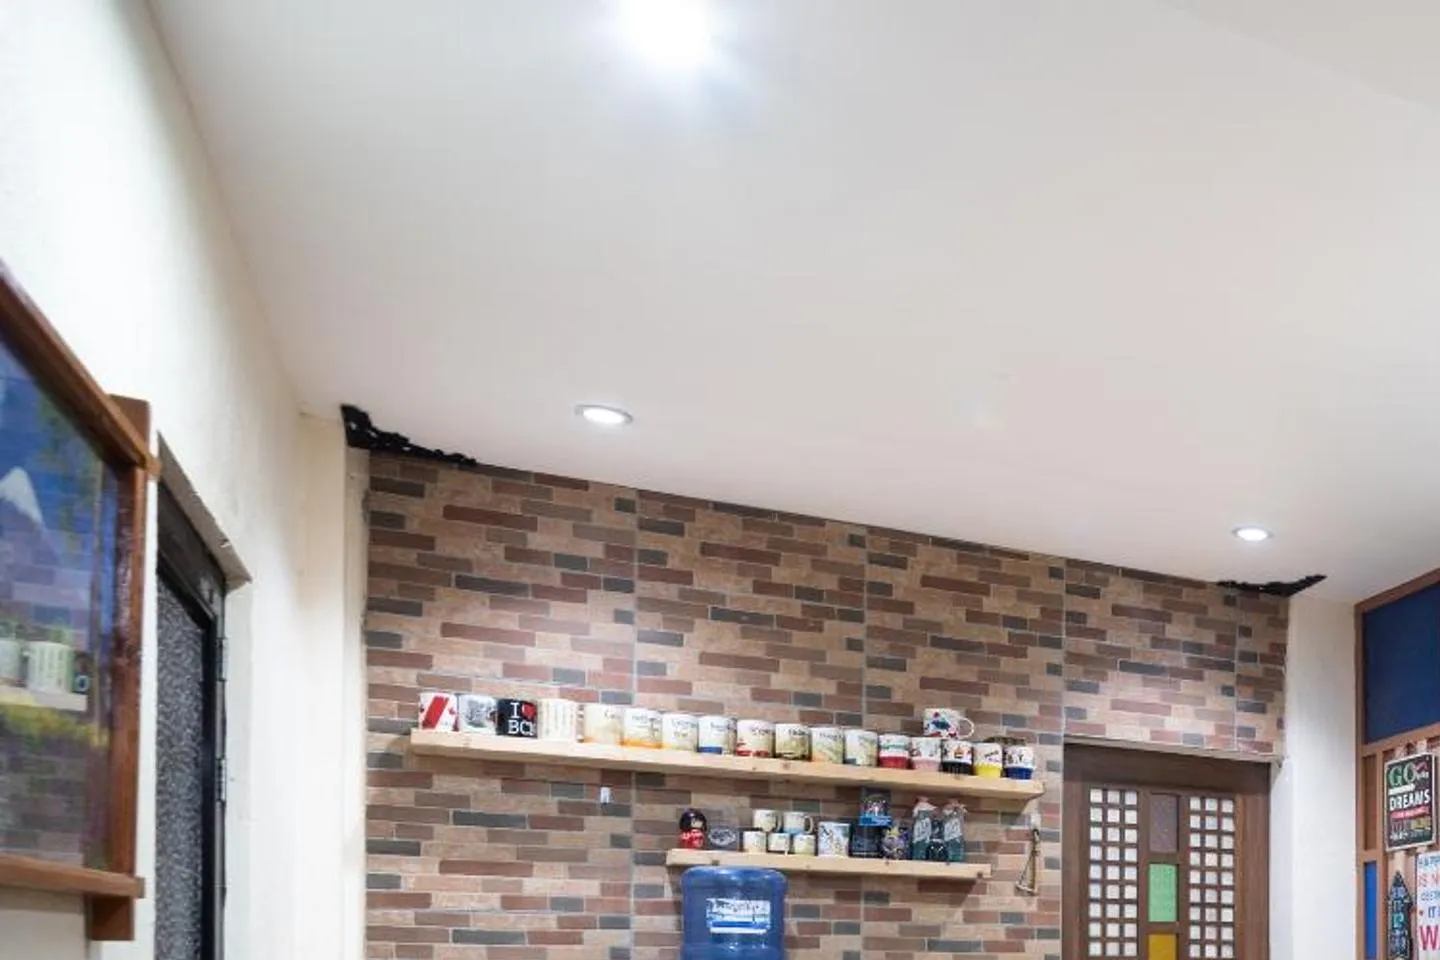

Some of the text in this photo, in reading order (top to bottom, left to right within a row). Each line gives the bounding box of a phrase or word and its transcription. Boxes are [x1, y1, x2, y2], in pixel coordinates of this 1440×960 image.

[1389, 762, 1416, 787] GO
[1389, 789, 1431, 811] DREAMS
[1428, 906, 1437, 918] IT
